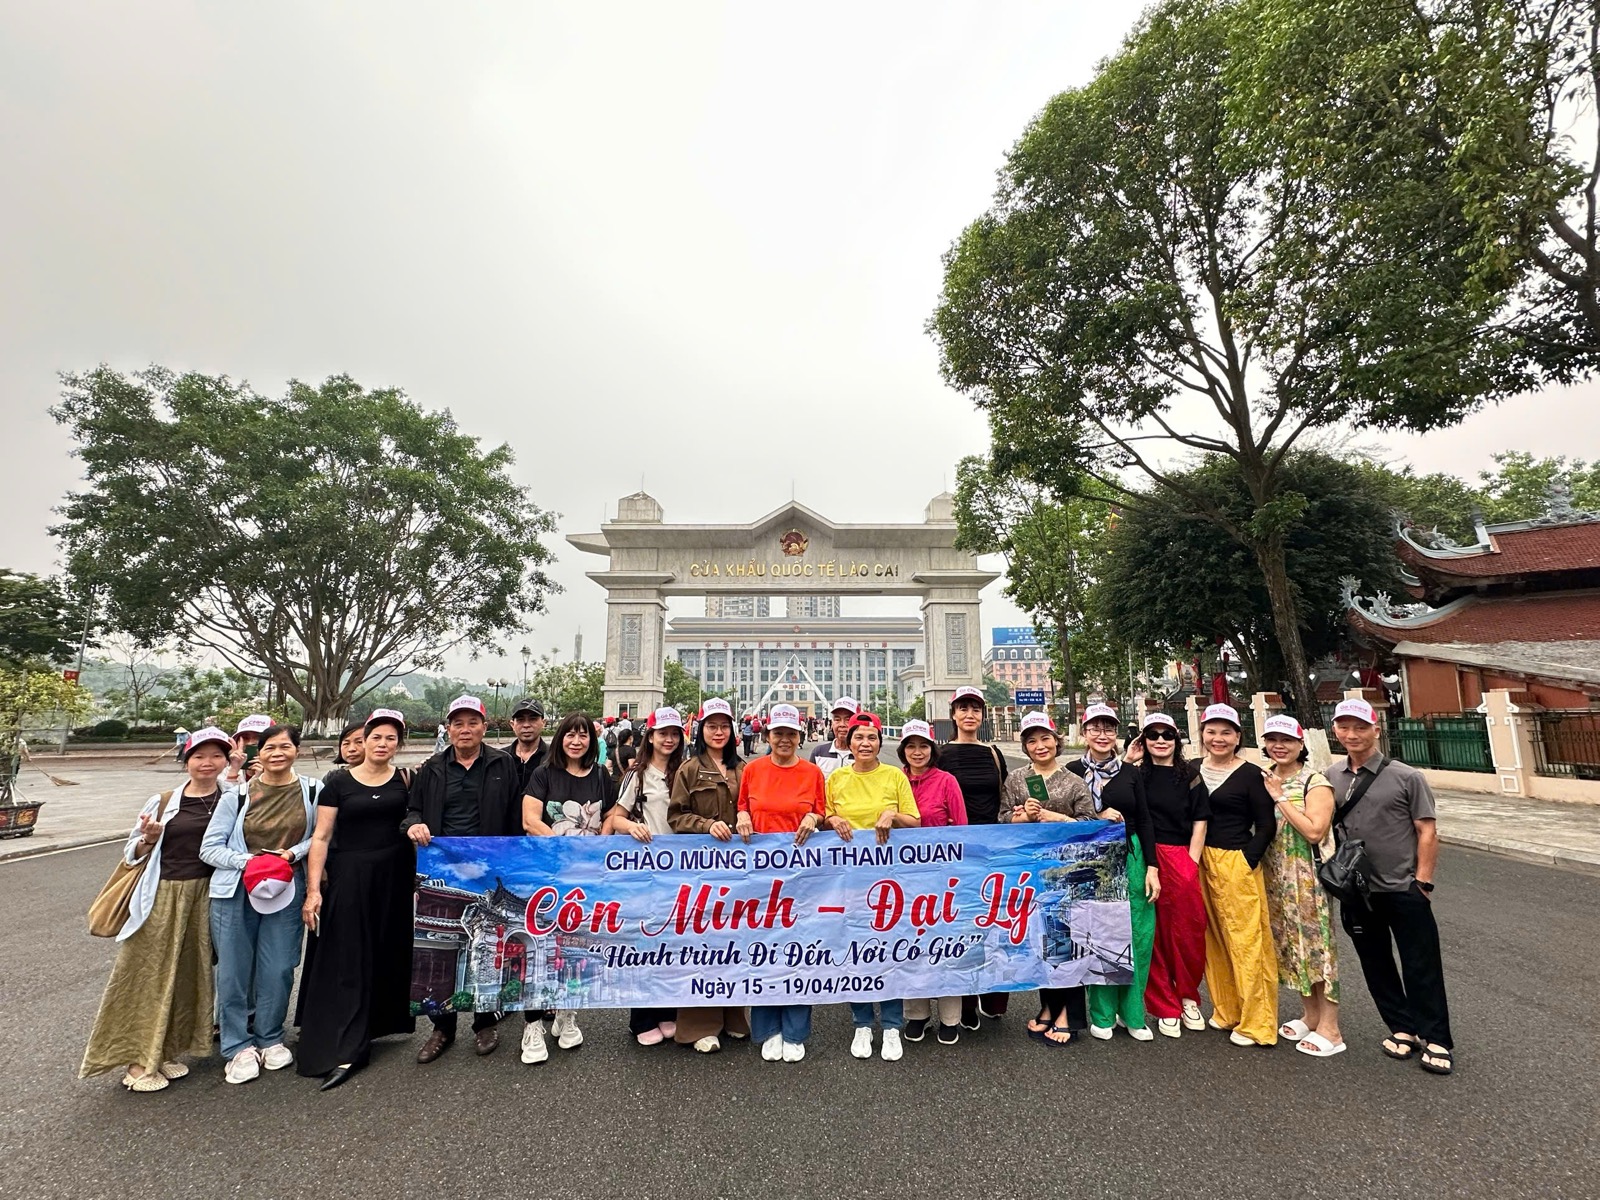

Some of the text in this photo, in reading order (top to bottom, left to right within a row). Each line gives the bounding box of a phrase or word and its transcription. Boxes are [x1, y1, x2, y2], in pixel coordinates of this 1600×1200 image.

[690, 557, 899, 578] CỬA KHẨU QUỐC TẾ LÀO CAI
[605, 843, 963, 870] CHÀO MỪNG ĐOÀN THAM QUAN
[525, 886, 624, 937] Côn
[641, 879, 798, 937] Minh
[867, 877, 959, 935] Đại
[975, 872, 1037, 945] Lý
[589, 934, 982, 968] “Hành trình Đi Đến Nơi Có Gió”
[691, 978, 735, 999] Ngày
[741, 978, 763, 995] 15
[784, 975, 885, 995] 19/04/2026
